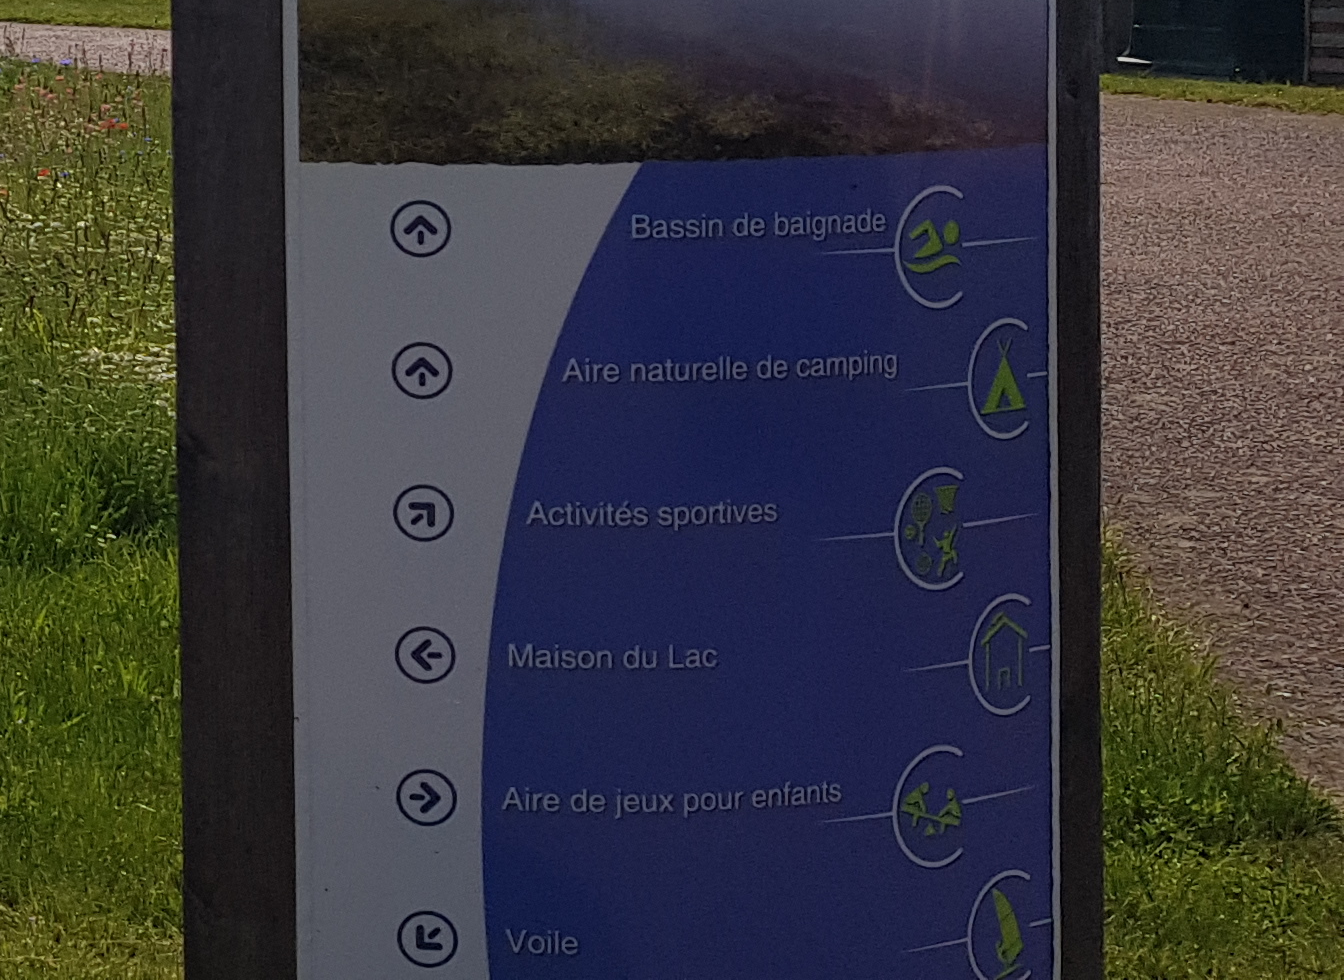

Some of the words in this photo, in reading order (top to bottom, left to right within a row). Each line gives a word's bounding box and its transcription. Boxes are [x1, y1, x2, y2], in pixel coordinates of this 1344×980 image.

[630, 213, 724, 239] Bassin
[731, 212, 766, 237] de
[773, 208, 887, 241] baignade
[561, 356, 620, 383] Aire
[629, 355, 748, 382] naturelle
[756, 353, 787, 379] de
[795, 350, 899, 381] camping
[525, 499, 649, 527] Activités
[656, 499, 778, 531] sportives
[507, 642, 613, 669] Maison
[622, 643, 658, 669] du
[668, 642, 718, 669] Lac
[500, 786, 560, 812] Aire
[569, 786, 606, 813] de
[613, 787, 674, 820] jeux
[682, 787, 744, 819] pour
[750, 779, 843, 807] enfants
[504, 927, 579, 956] Voile
